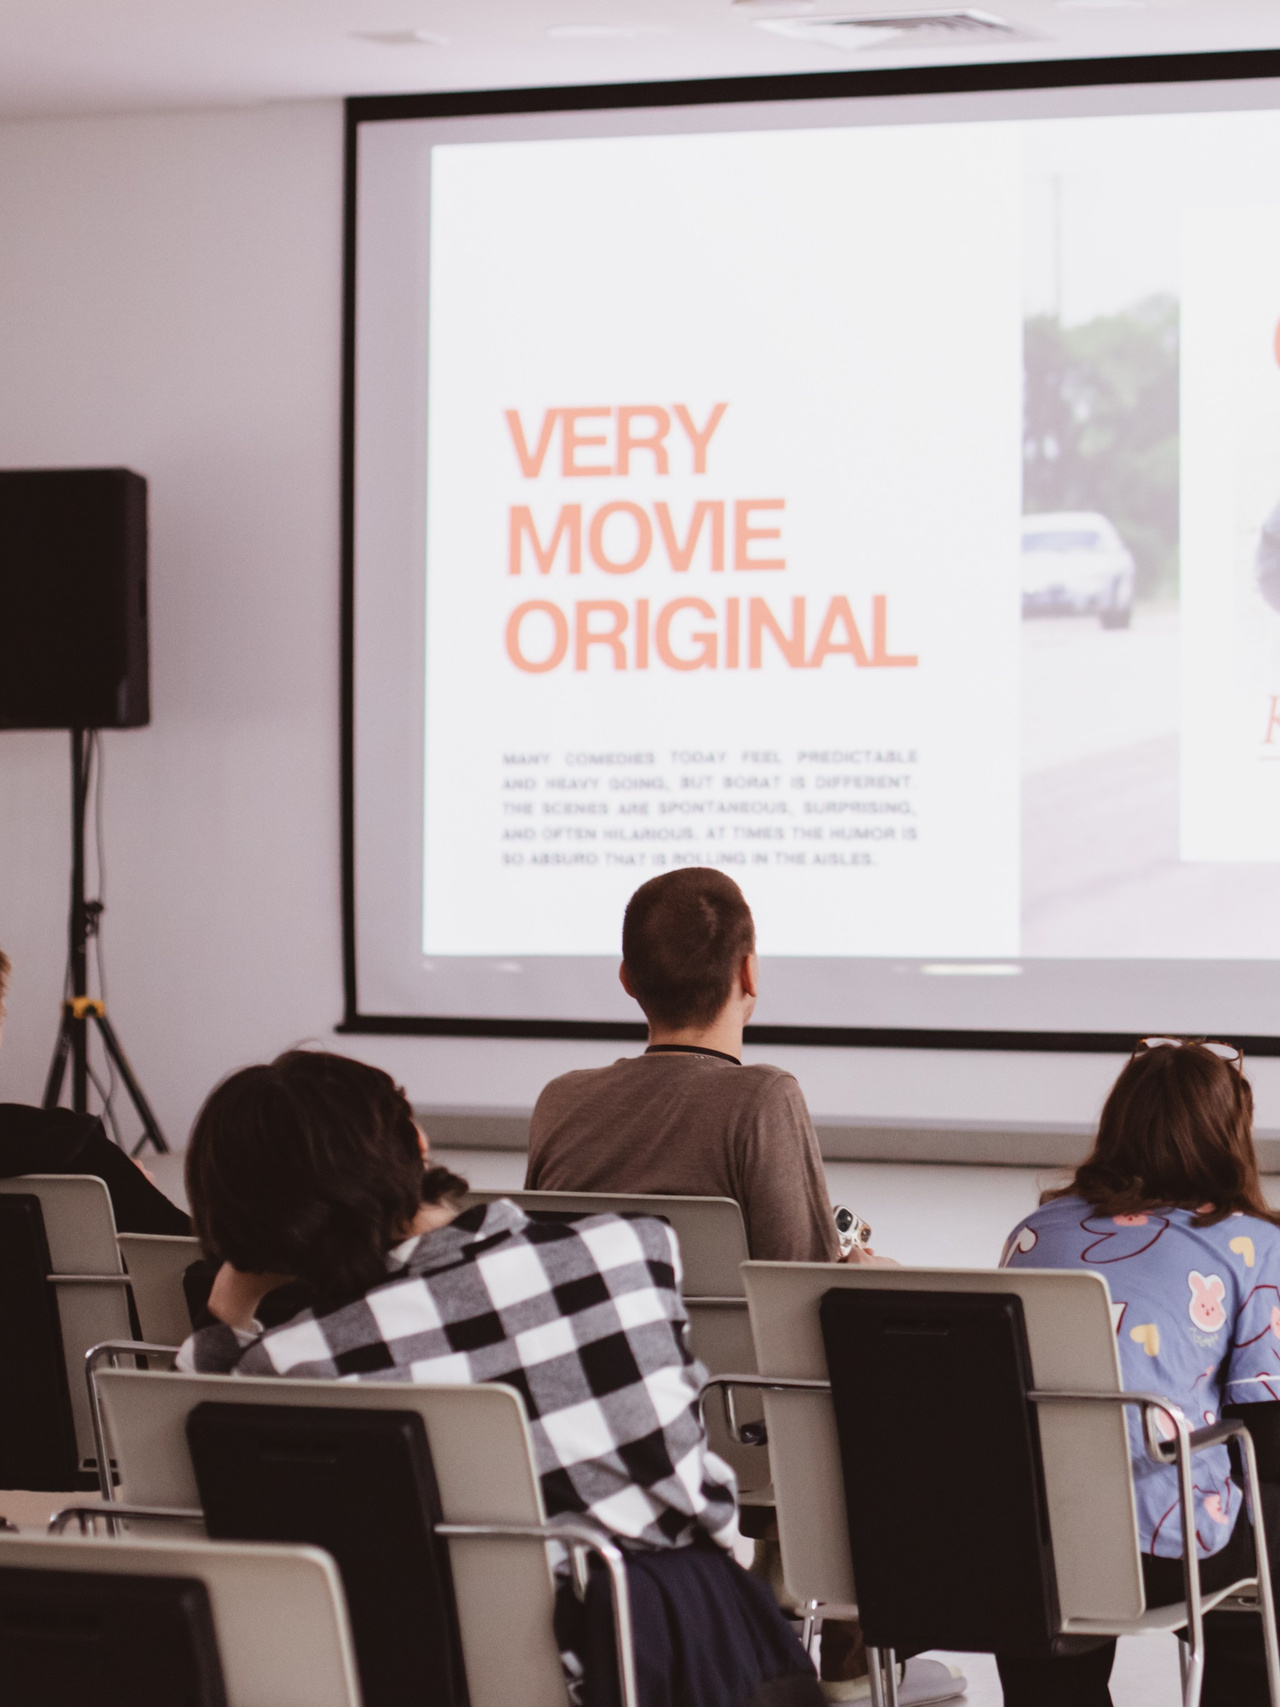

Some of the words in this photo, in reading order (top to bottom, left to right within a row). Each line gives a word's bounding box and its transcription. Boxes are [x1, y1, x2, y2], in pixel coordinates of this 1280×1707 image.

[504, 402, 729, 479] VERY
[508, 497, 787, 577] MOVIE
[504, 594, 919, 675] ORIGINAL
[501, 752, 551, 766] MANY
[564, 751, 657, 767] COMEDIES
[669, 750, 728, 765] TODAY
[741, 750, 782, 765] FEEL
[796, 749, 919, 764] PREDICTABLE
[501, 776, 538, 792] AND
[545, 776, 601, 792] HEAVY
[679, 774, 714, 790] BUT
[722, 775, 782, 790] BORAT
[789, 775, 807, 791] IS
[502, 801, 535, 816] THE
[541, 801, 610, 816] SCENES
[616, 801, 651, 817] ARE
[500, 826, 538, 842] AND
[540, 826, 598, 842] OFTEN
[705, 825, 727, 840] AT
[731, 825, 786, 841] TIMES
[791, 826, 825, 841] THE
[829, 826, 897, 842] HUMOR
[901, 826, 919, 842] IS
[501, 851, 526, 867] SO
[527, 851, 600, 867] ABSURD
[604, 851, 647, 867] THAT
[650, 852, 669, 866] IS
[670, 851, 748, 866] ROLLING
[751, 851, 770, 866] IN
[774, 851, 808, 866] THE
